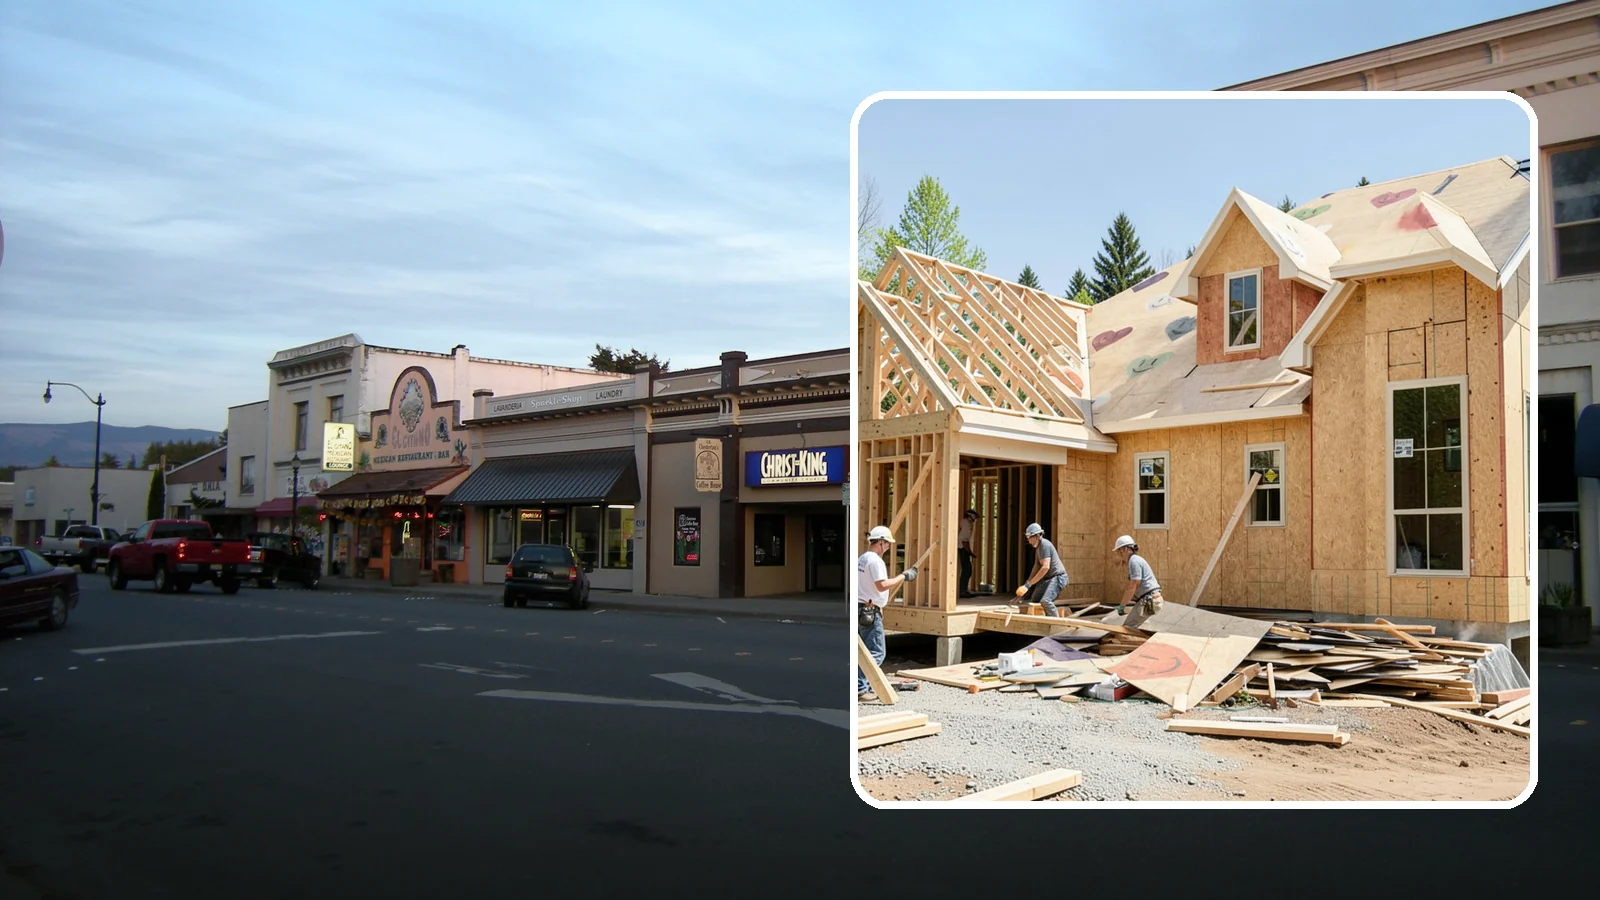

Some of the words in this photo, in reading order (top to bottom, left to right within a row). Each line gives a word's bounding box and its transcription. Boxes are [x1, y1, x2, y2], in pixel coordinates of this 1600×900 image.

[493, 402, 523, 413] LAVANDERIA
[530, 395, 561, 408] Sparkle
[561, 393, 582, 404] Shop
[595, 389, 624, 400] LAUNDRY
[373, 455, 396, 464] MEXICAN
[397, 451, 433, 462] RESTAURANT
[438, 450, 450, 459] BAR
[760, 451, 797, 478] CHRIST
[799, 450, 827, 477] KING
[696, 480, 709, 489] Coffee
[709, 480, 722, 489] House
